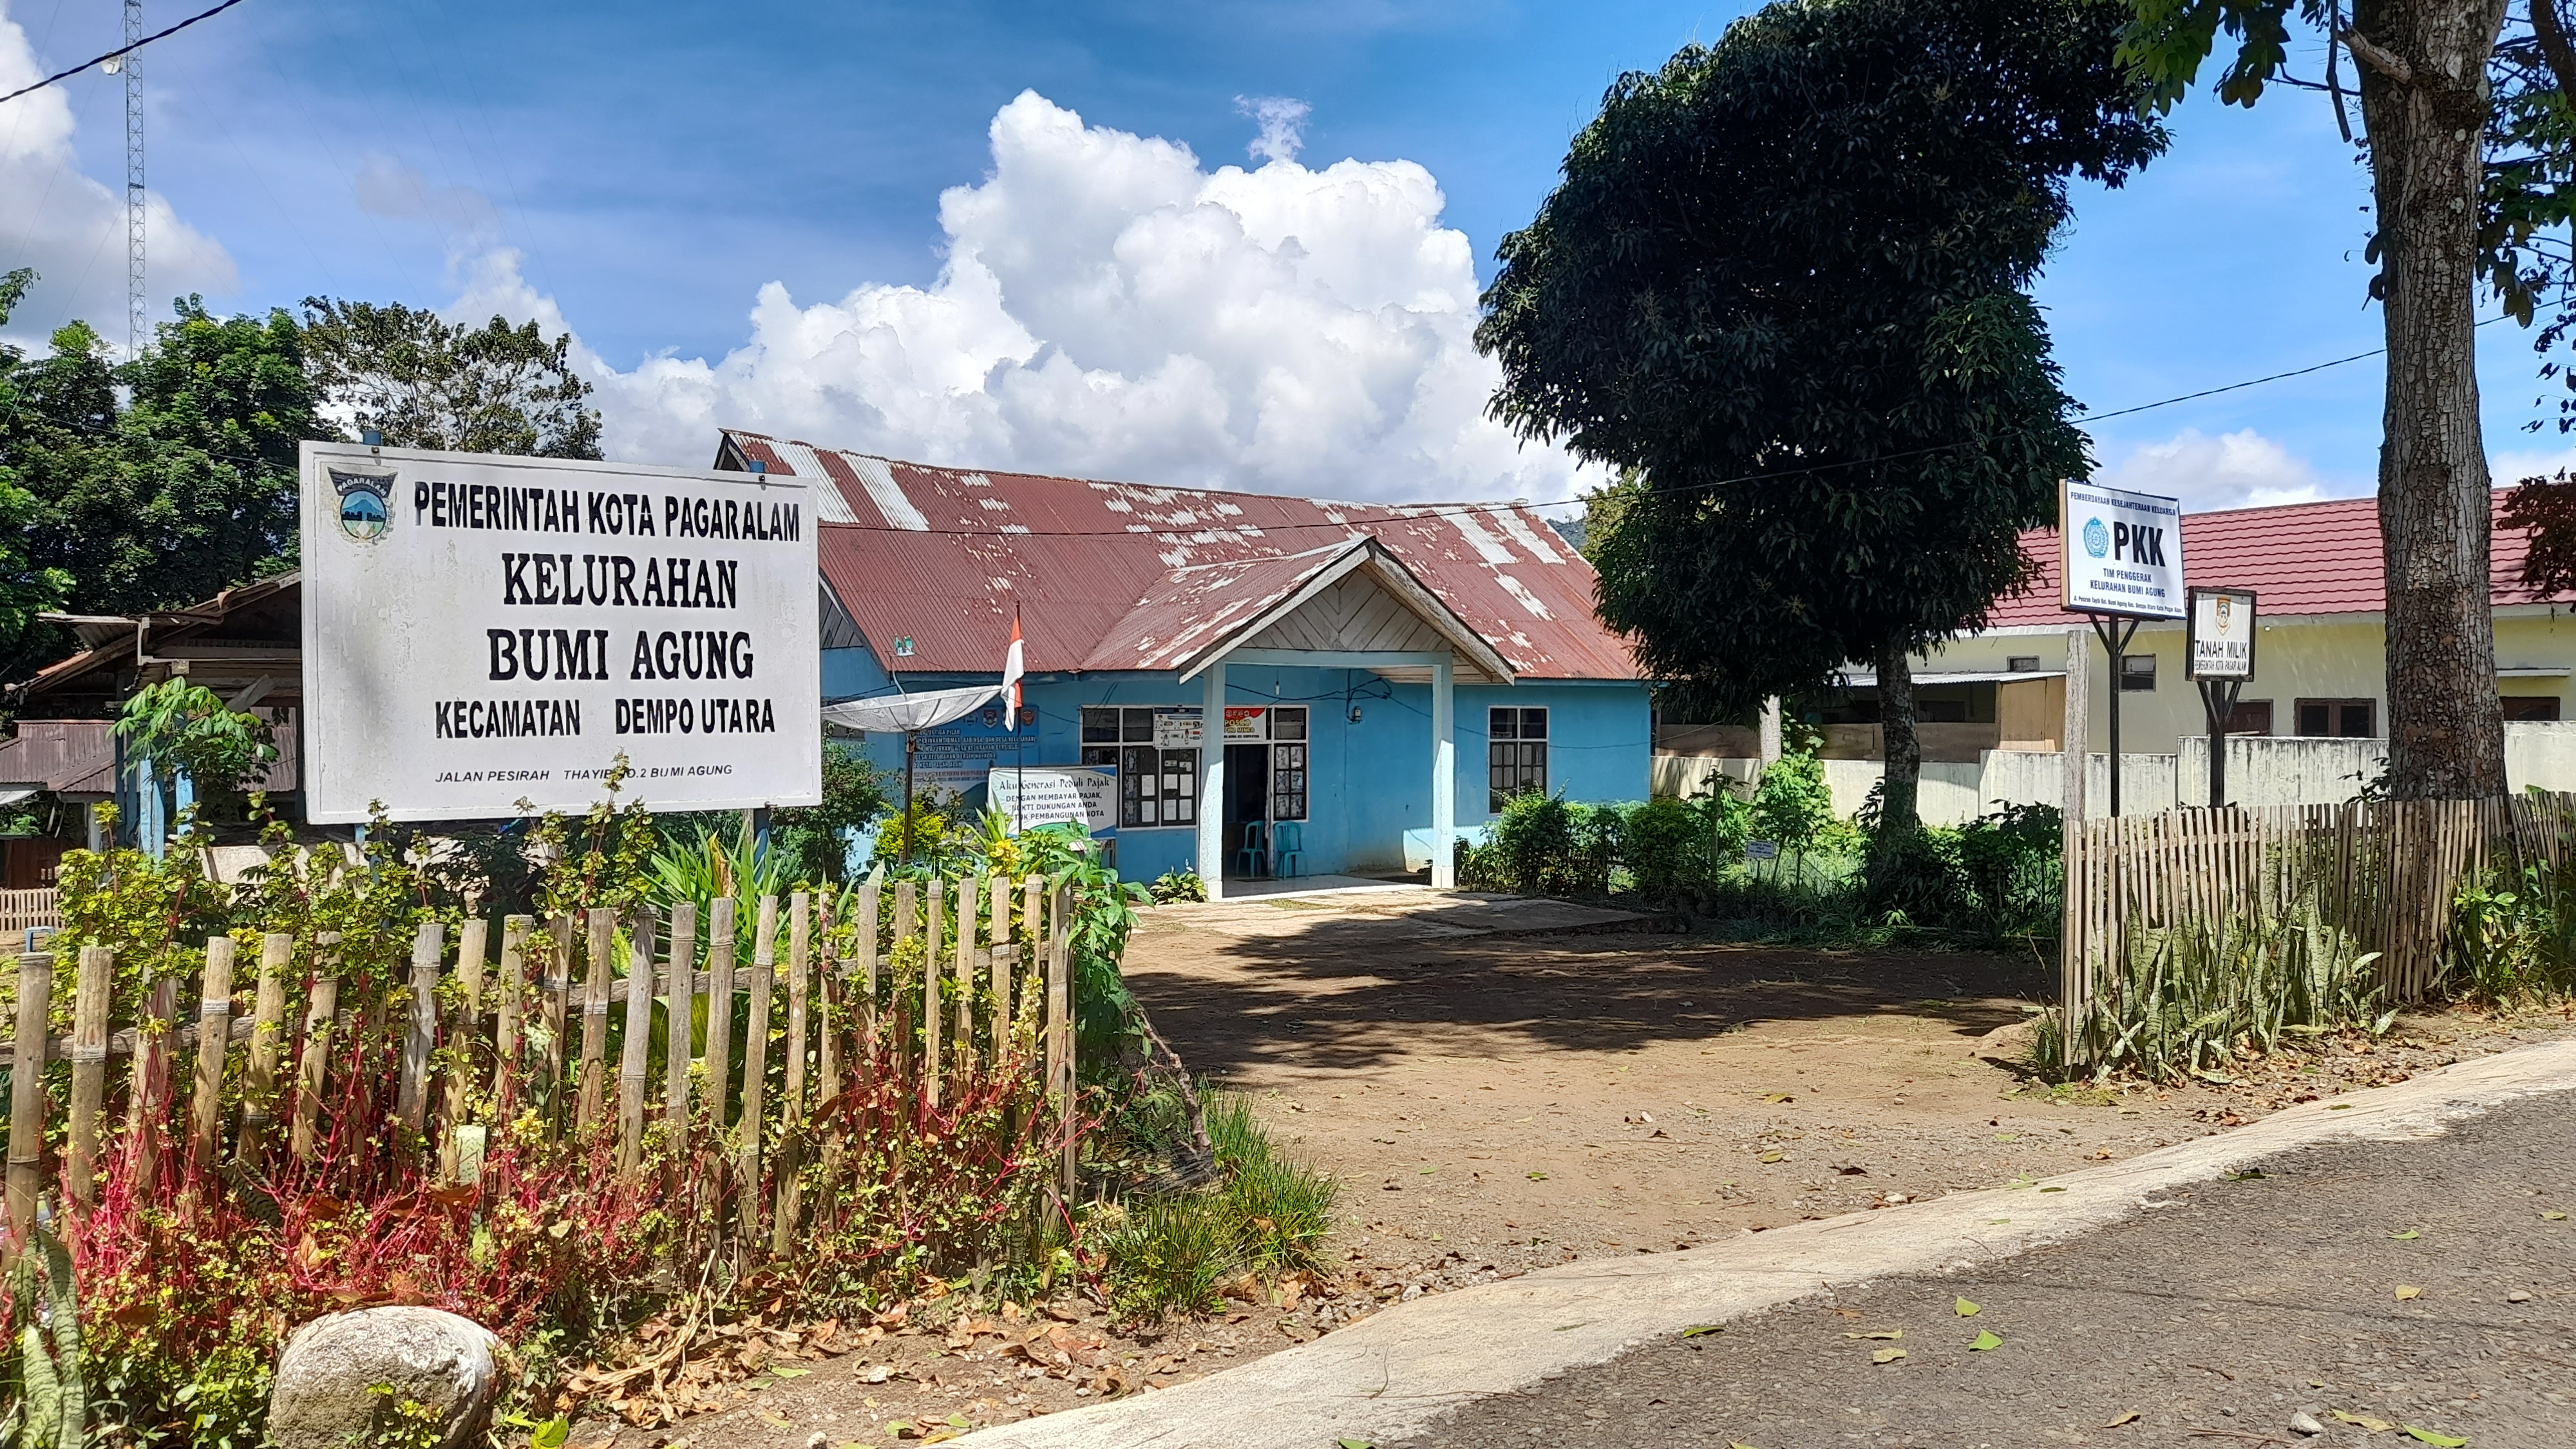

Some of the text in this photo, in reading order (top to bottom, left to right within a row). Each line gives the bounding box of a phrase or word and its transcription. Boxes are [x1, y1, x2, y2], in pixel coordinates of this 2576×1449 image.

[337, 477, 386, 496] PAGARALAM
[414, 481, 580, 533] PEMERINTAH
[588, 491, 656, 537] KOTA
[2070, 491, 2176, 516] PEMBERDAYAAN KESEJAHTERAAN KELUARGA
[2114, 521, 2166, 567] PKK
[502, 553, 738, 609] KELURAHAN
[2103, 568, 2152, 583] TIM PENGGERAK
[2090, 580, 2166, 598] KELURAHAN BUMI AGUNG
[487, 629, 753, 680] BUMI AGUNG
[2195, 639, 2248, 659] TANAH MILIK
[2215, 660, 2224, 670] KOTA
[2225, 660, 2237, 671] PAGAR
[2237, 661, 2247, 671] ALAM
[435, 698, 775, 738] KECAMATAN DEMPO UTARA
[435, 772, 483, 783] JALAN
[487, 770, 549, 782] PESIRAH
[650, 767, 684, 779] BUMI
[687, 764, 733, 777] AGUNG
[999, 779, 1018, 790] Aku
[1020, 779, 1056, 790] Generasi
[1059, 777, 1083, 788] Peduli
[1086, 777, 1110, 790] Pajak
[1030, 811, 1084, 820] PEMBANGUNAN
